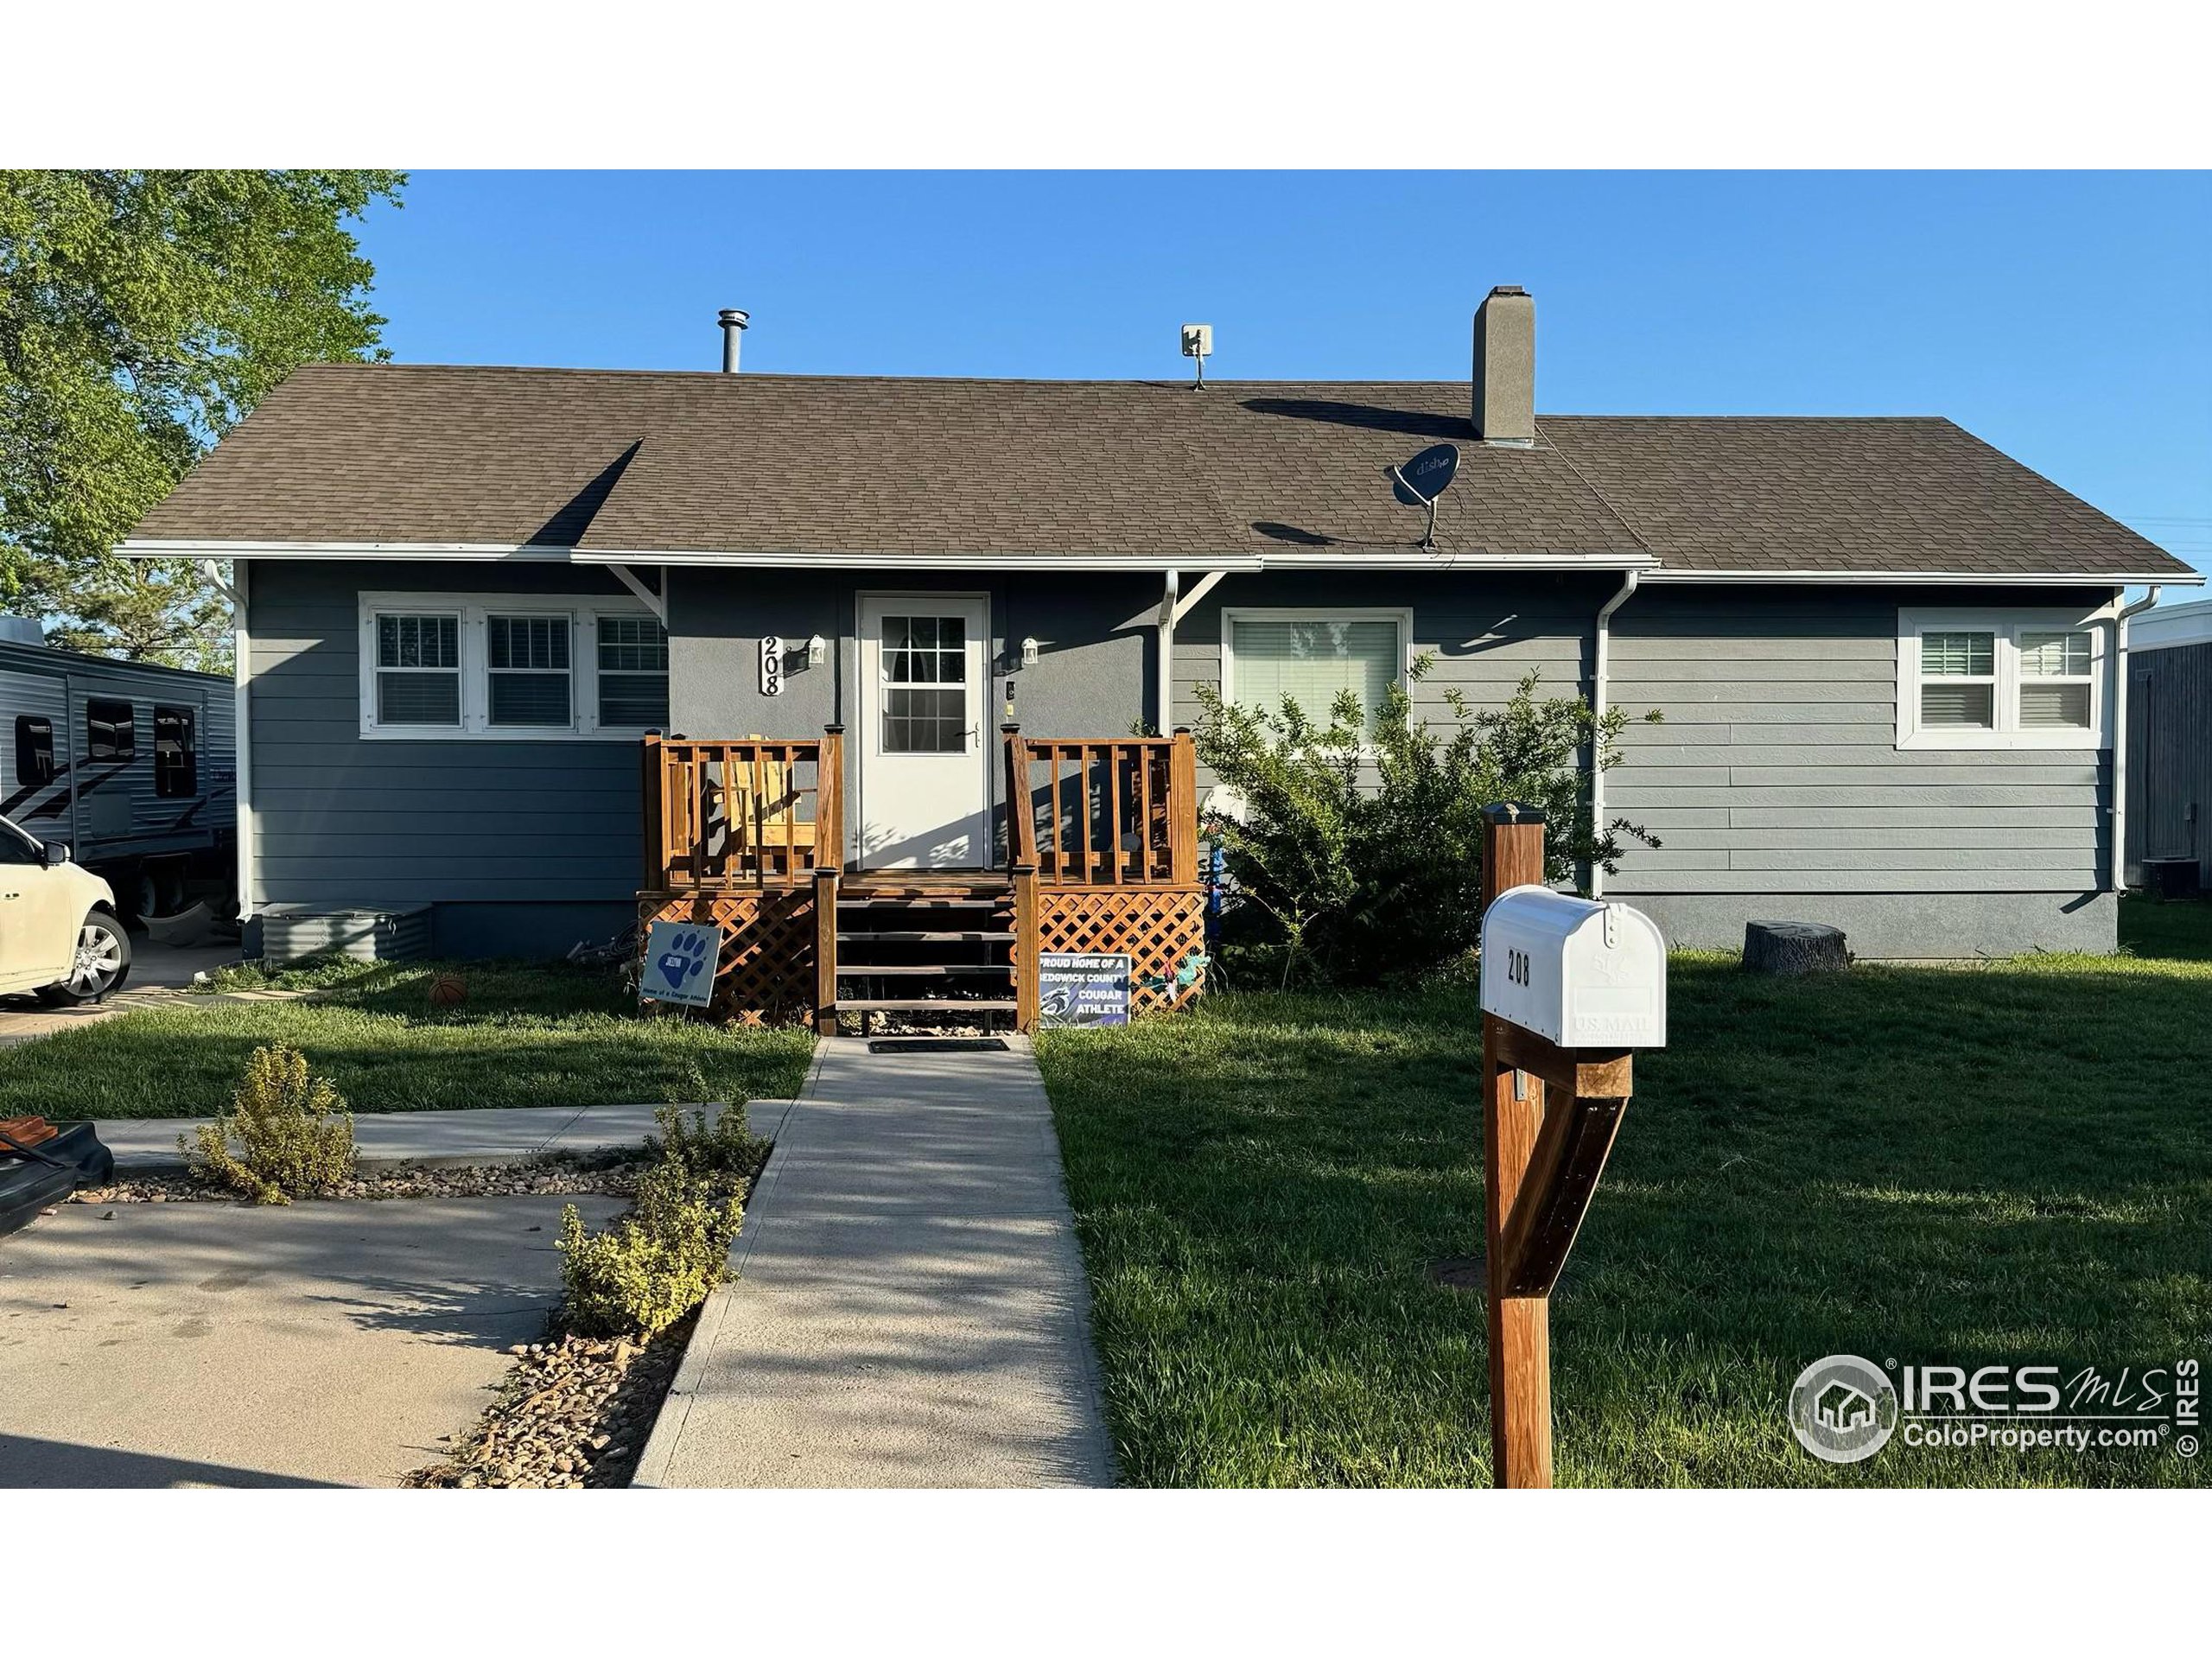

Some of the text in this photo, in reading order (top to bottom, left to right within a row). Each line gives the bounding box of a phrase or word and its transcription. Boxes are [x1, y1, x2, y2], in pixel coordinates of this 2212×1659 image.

[765, 636, 779, 695] 208
[1072, 959, 1100, 969] HOME
[1101, 959, 1115, 969] OF
[1116, 960, 1124, 969] A
[1508, 949, 1530, 987] 208
[1086, 974, 1126, 983] COUNTY
[1078, 989, 1122, 1000] COUGAR
[1077, 1004, 1125, 1014] ATHLETE
[1603, 1016, 1653, 1032] MAIL
